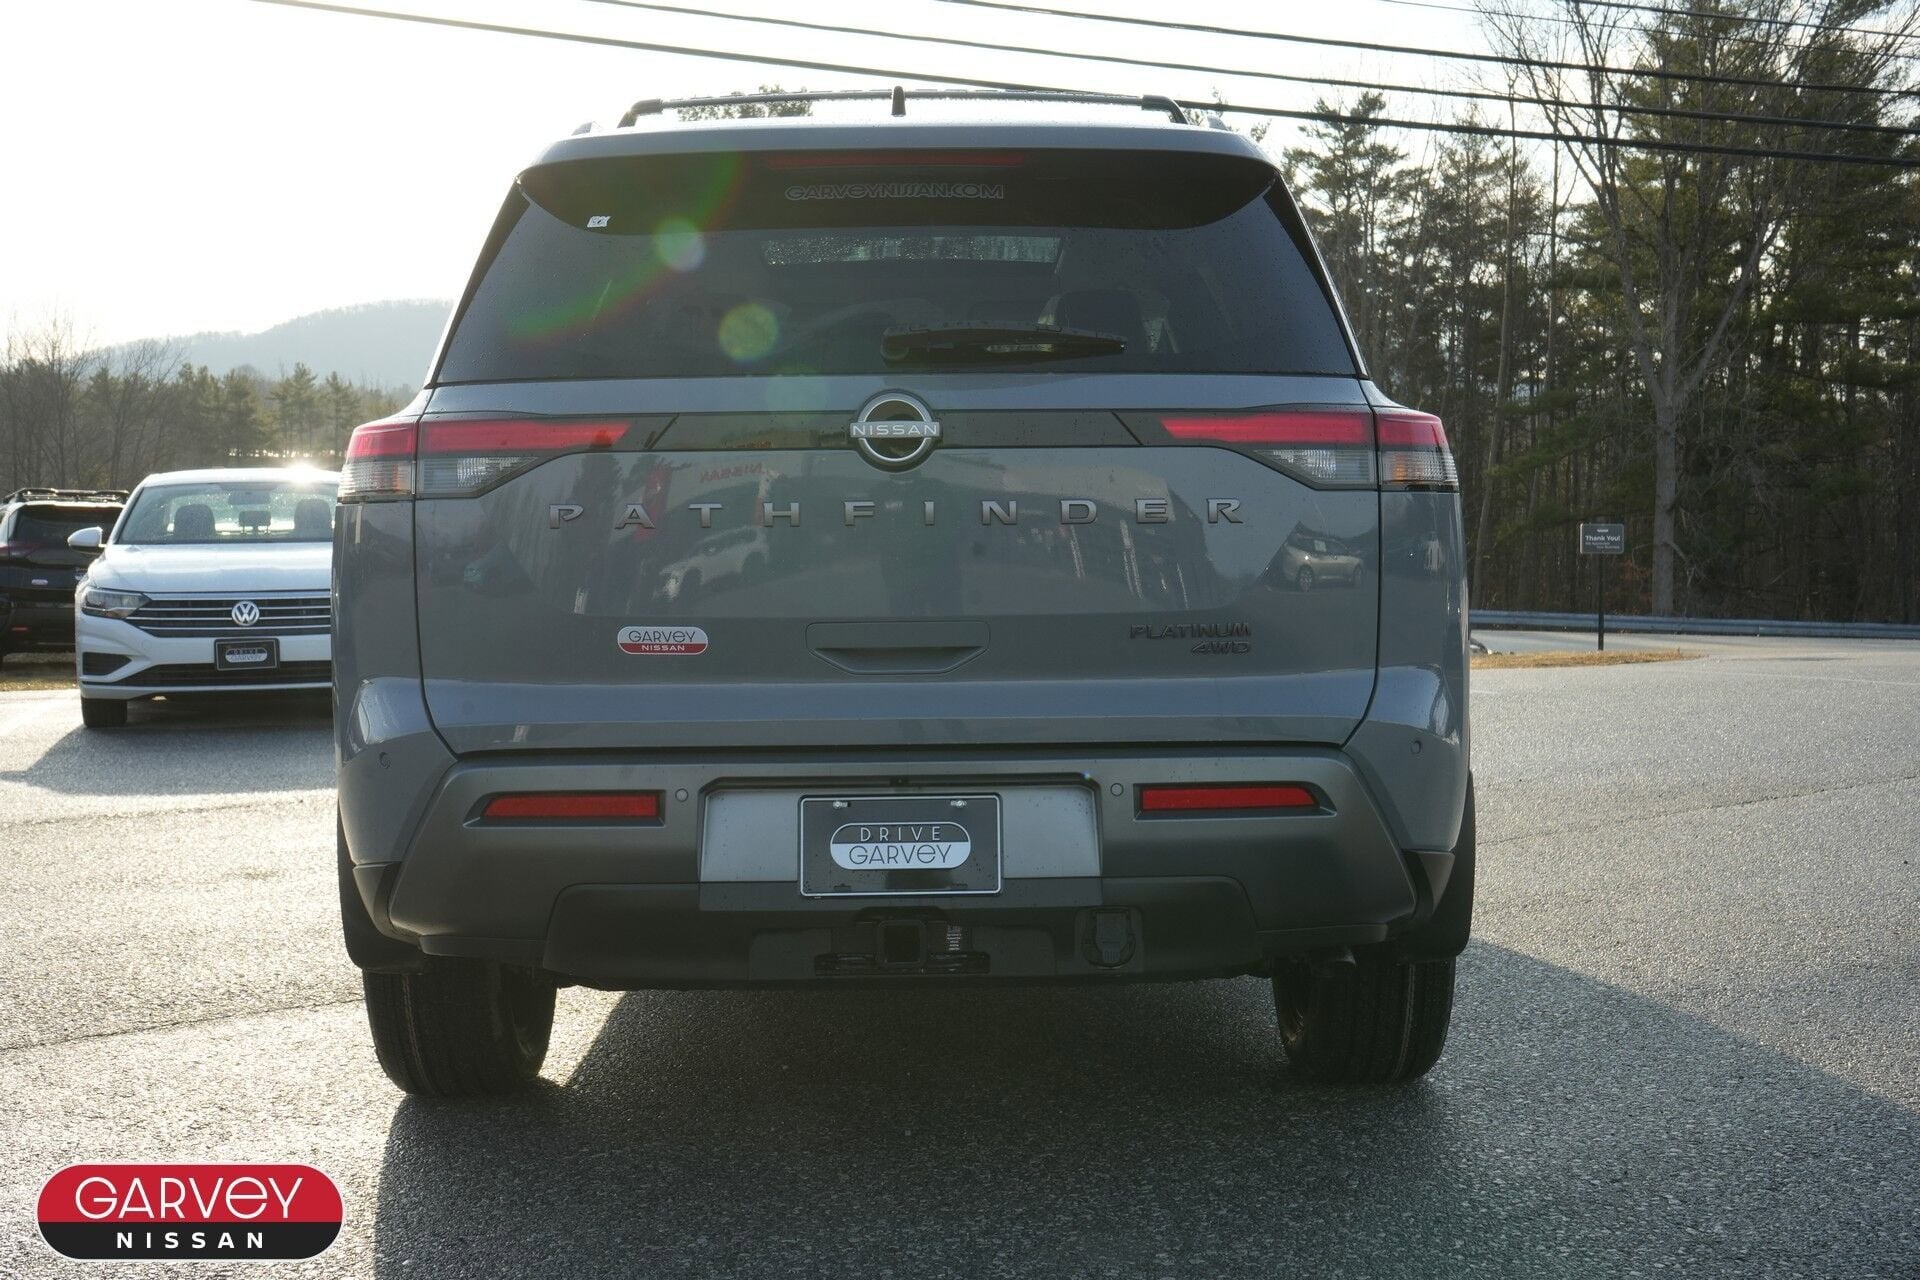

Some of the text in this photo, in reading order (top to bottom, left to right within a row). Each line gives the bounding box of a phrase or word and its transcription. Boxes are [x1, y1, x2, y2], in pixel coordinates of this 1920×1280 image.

[852, 424, 937, 436] NISSAN
[548, 497, 1244, 529] PATHFINDER
[1129, 622, 1251, 640] PLATINUM
[1191, 640, 1249, 655] 4WD
[860, 826, 941, 842] DRIVE
